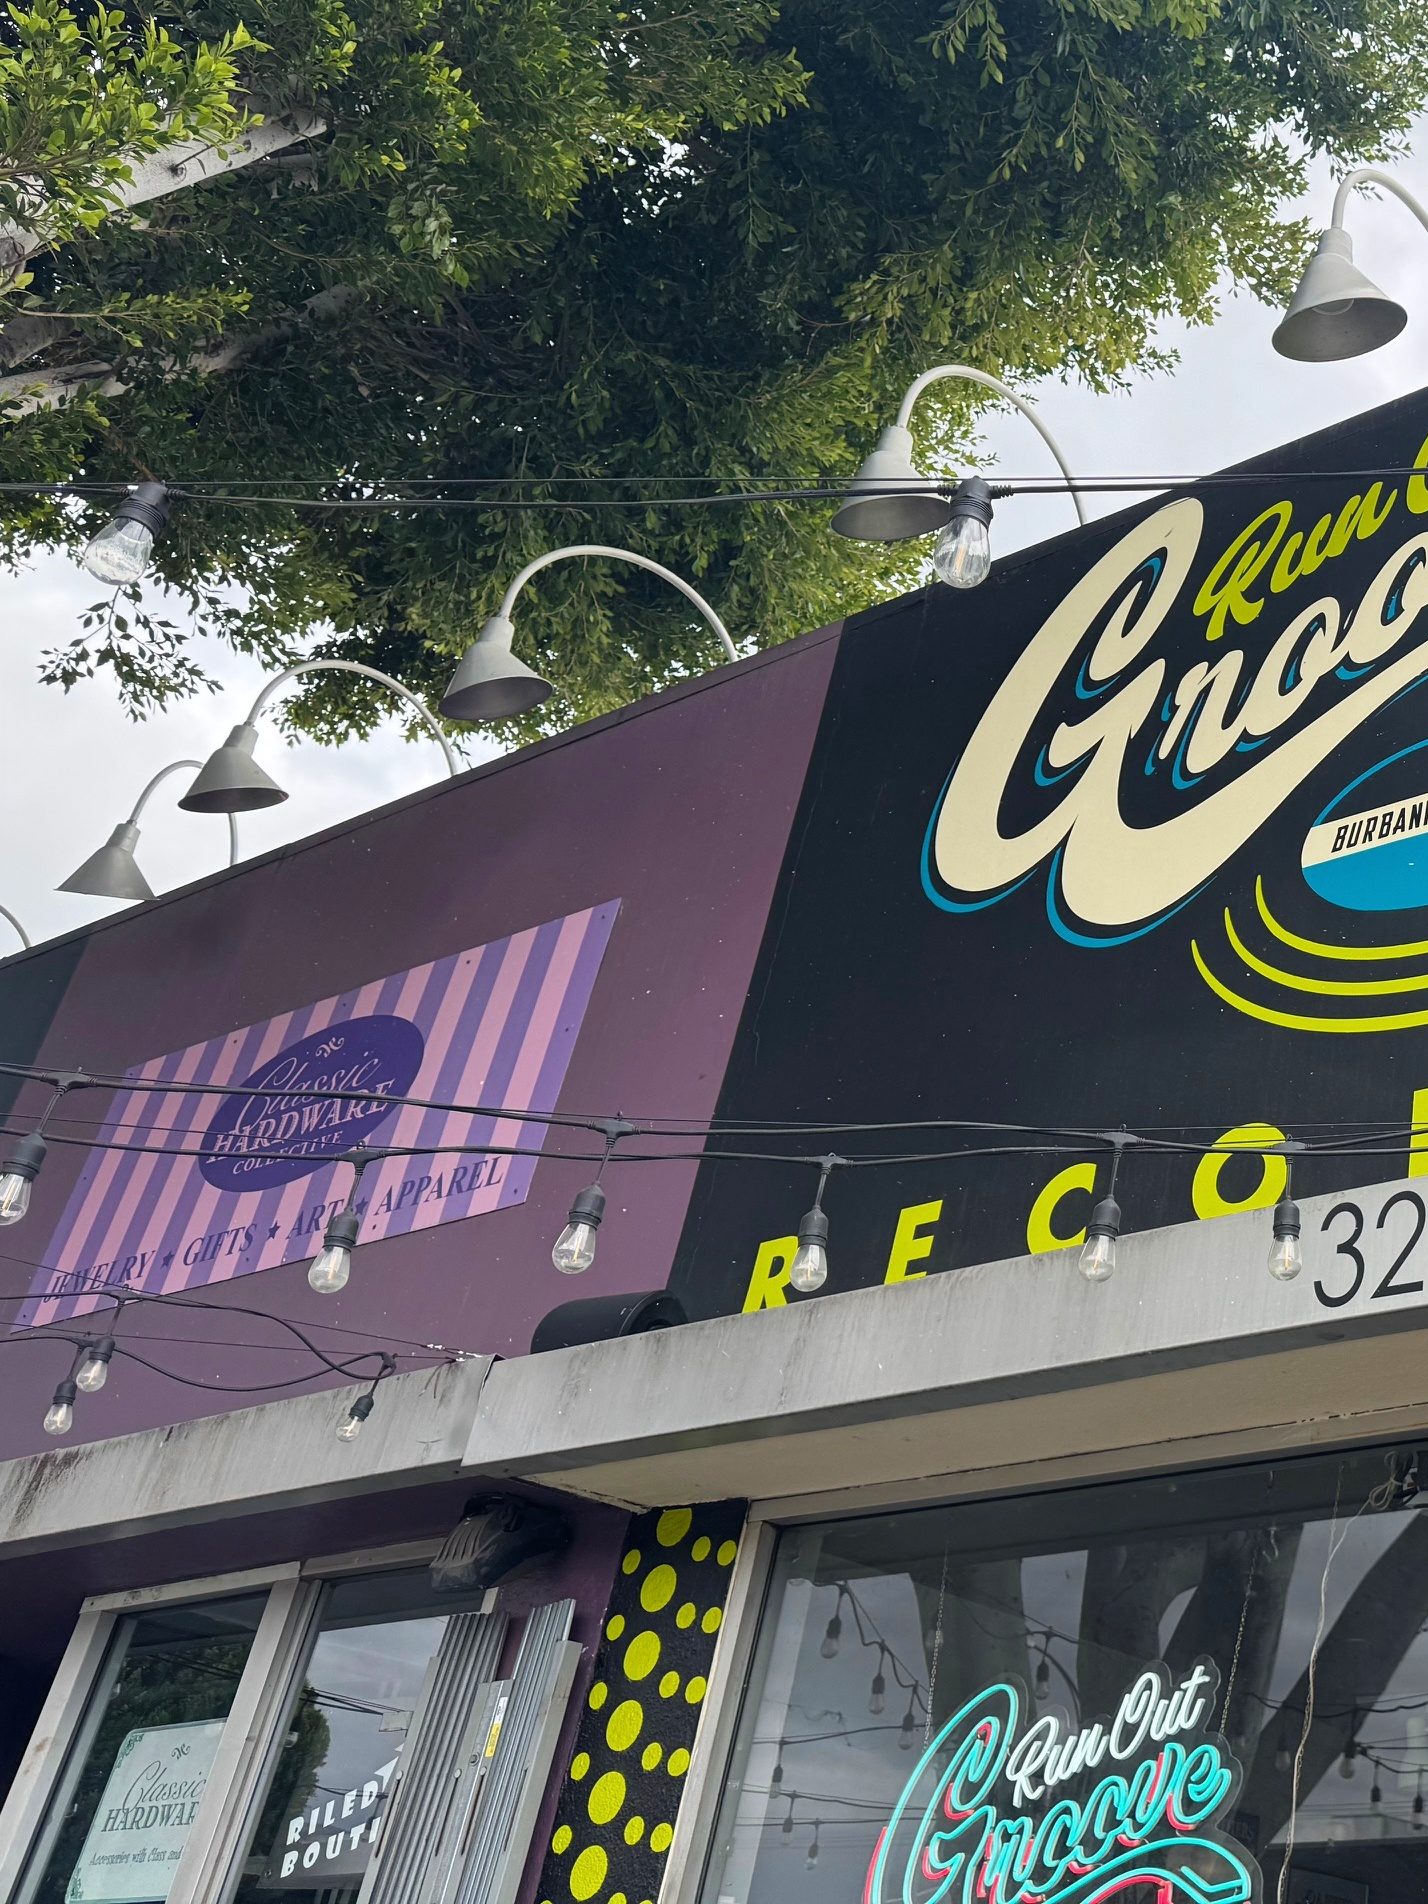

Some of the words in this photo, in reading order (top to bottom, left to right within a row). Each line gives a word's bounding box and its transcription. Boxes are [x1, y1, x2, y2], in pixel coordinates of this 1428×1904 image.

[1193, 481, 1398, 640] Run
[205, 1079, 397, 1164] HARDWARE
[234, 1051, 381, 1132] Classic
[43, 1250, 156, 1303] JEWELRY
[183, 1223, 257, 1266] GIFTS
[286, 1199, 345, 1240] ART
[374, 1156, 502, 1216] APPAREL
[122, 1760, 207, 1813] Classic
[864, 1683, 1232, 1904] Groove
[1005, 1715, 1108, 1808] Run
[1110, 1665, 1211, 1760] Out
[286, 1780, 379, 1846] RILED
